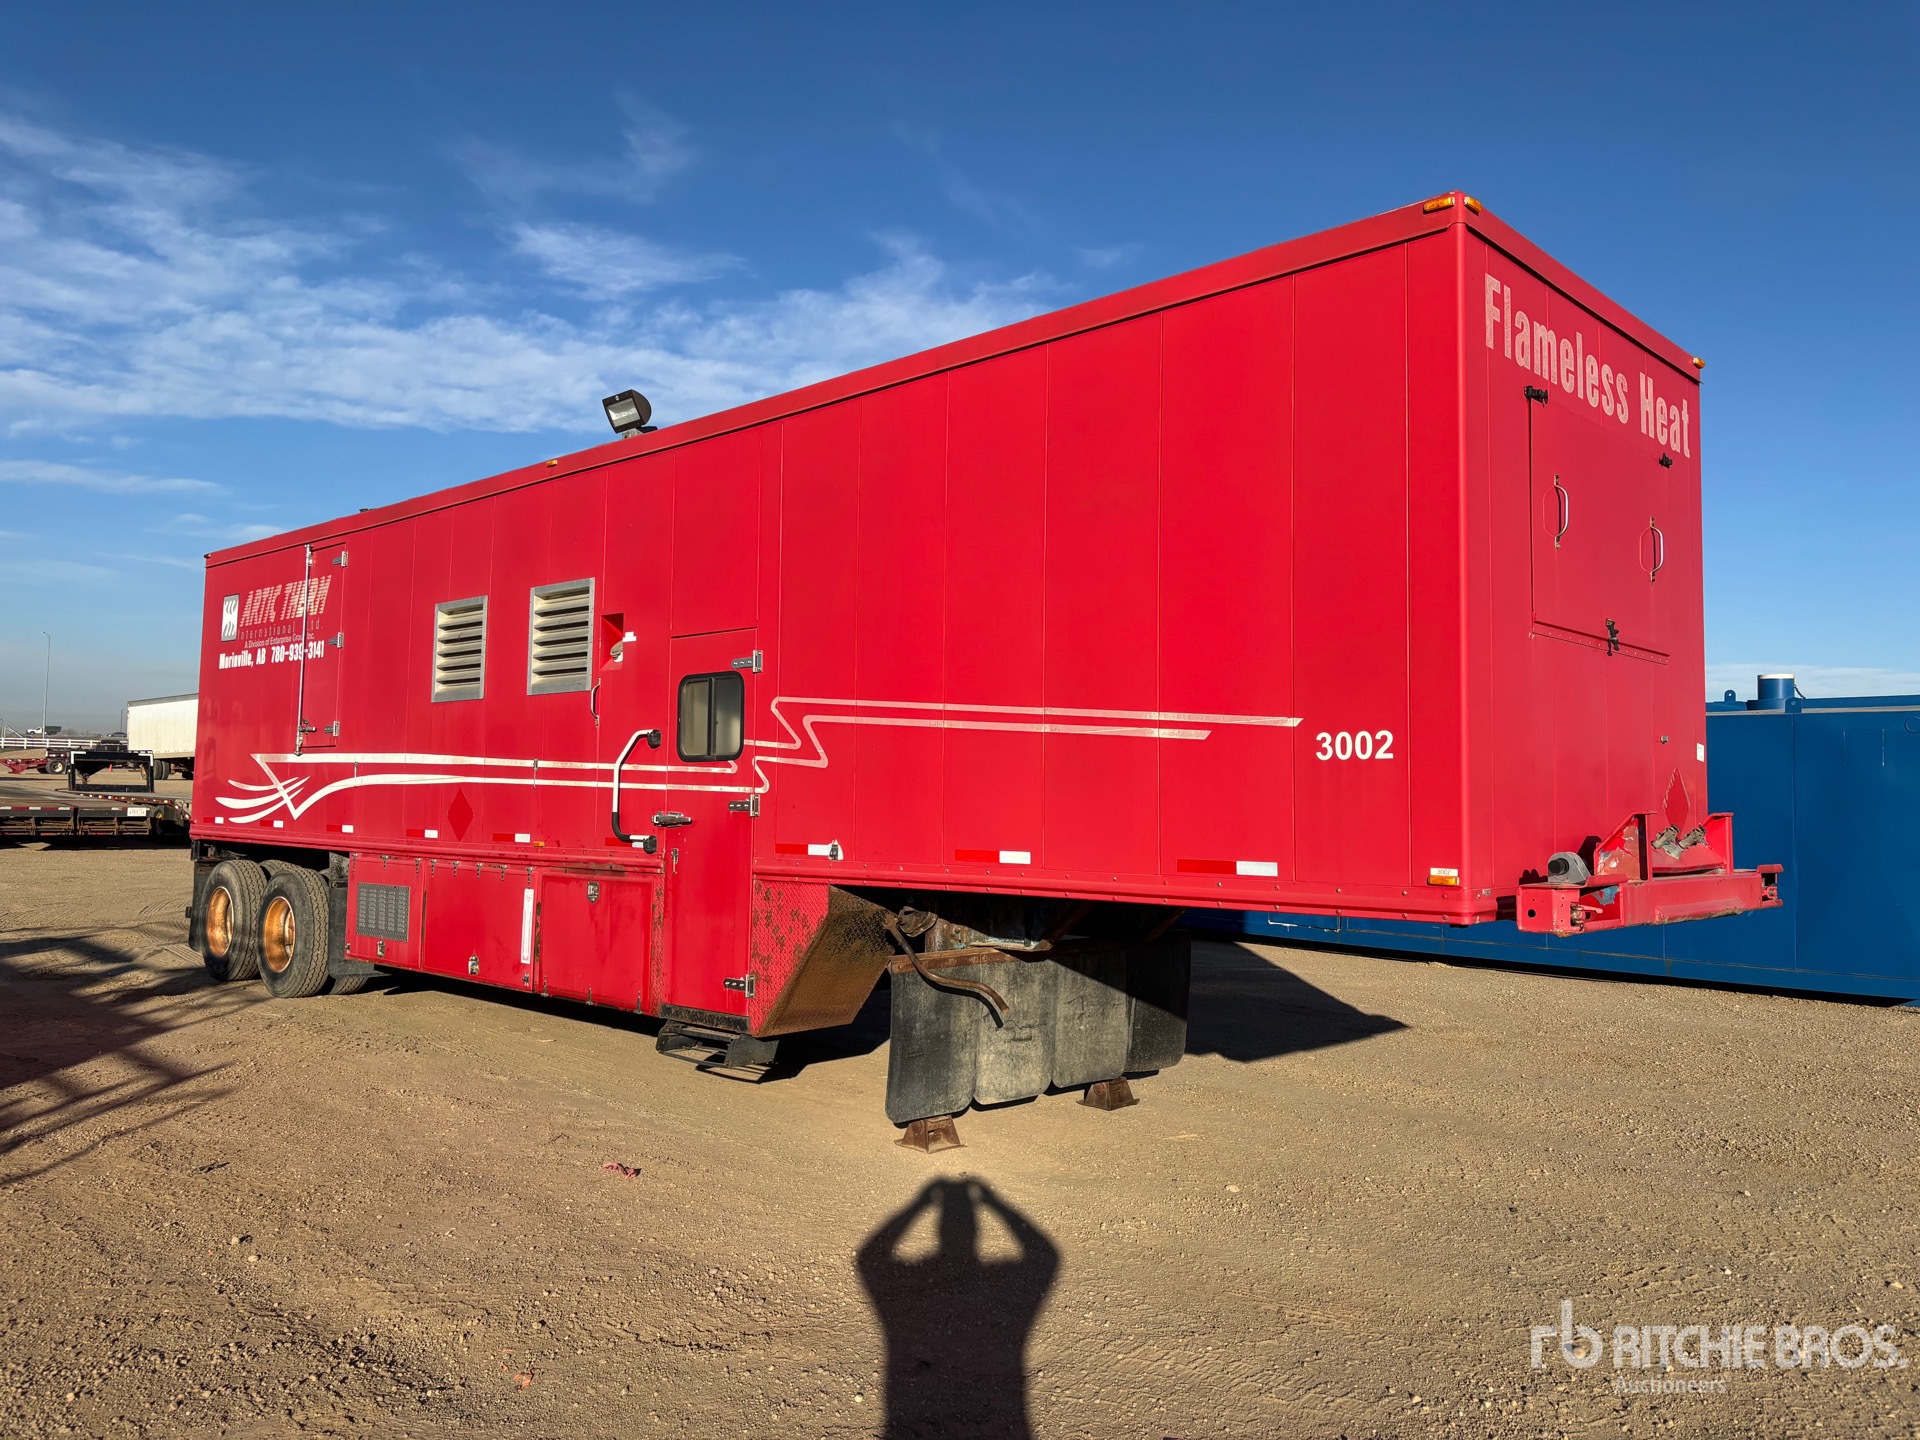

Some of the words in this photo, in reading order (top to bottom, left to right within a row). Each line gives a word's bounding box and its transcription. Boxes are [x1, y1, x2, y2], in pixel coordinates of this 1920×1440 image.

[1485, 273, 1629, 424] Flameless
[1639, 372, 1691, 459] Heat
[239, 584, 283, 627] ARTIC
[237, 620, 295, 640] International
[249, 638, 265, 648] Division
[265, 637, 270, 646] of
[270, 634, 292, 646] Enterprise
[218, 650, 254, 670] Morinville,
[256, 647, 266, 665] AB
[271, 640, 325, 663] 780-939-3141
[1315, 730, 1394, 761] 3002
